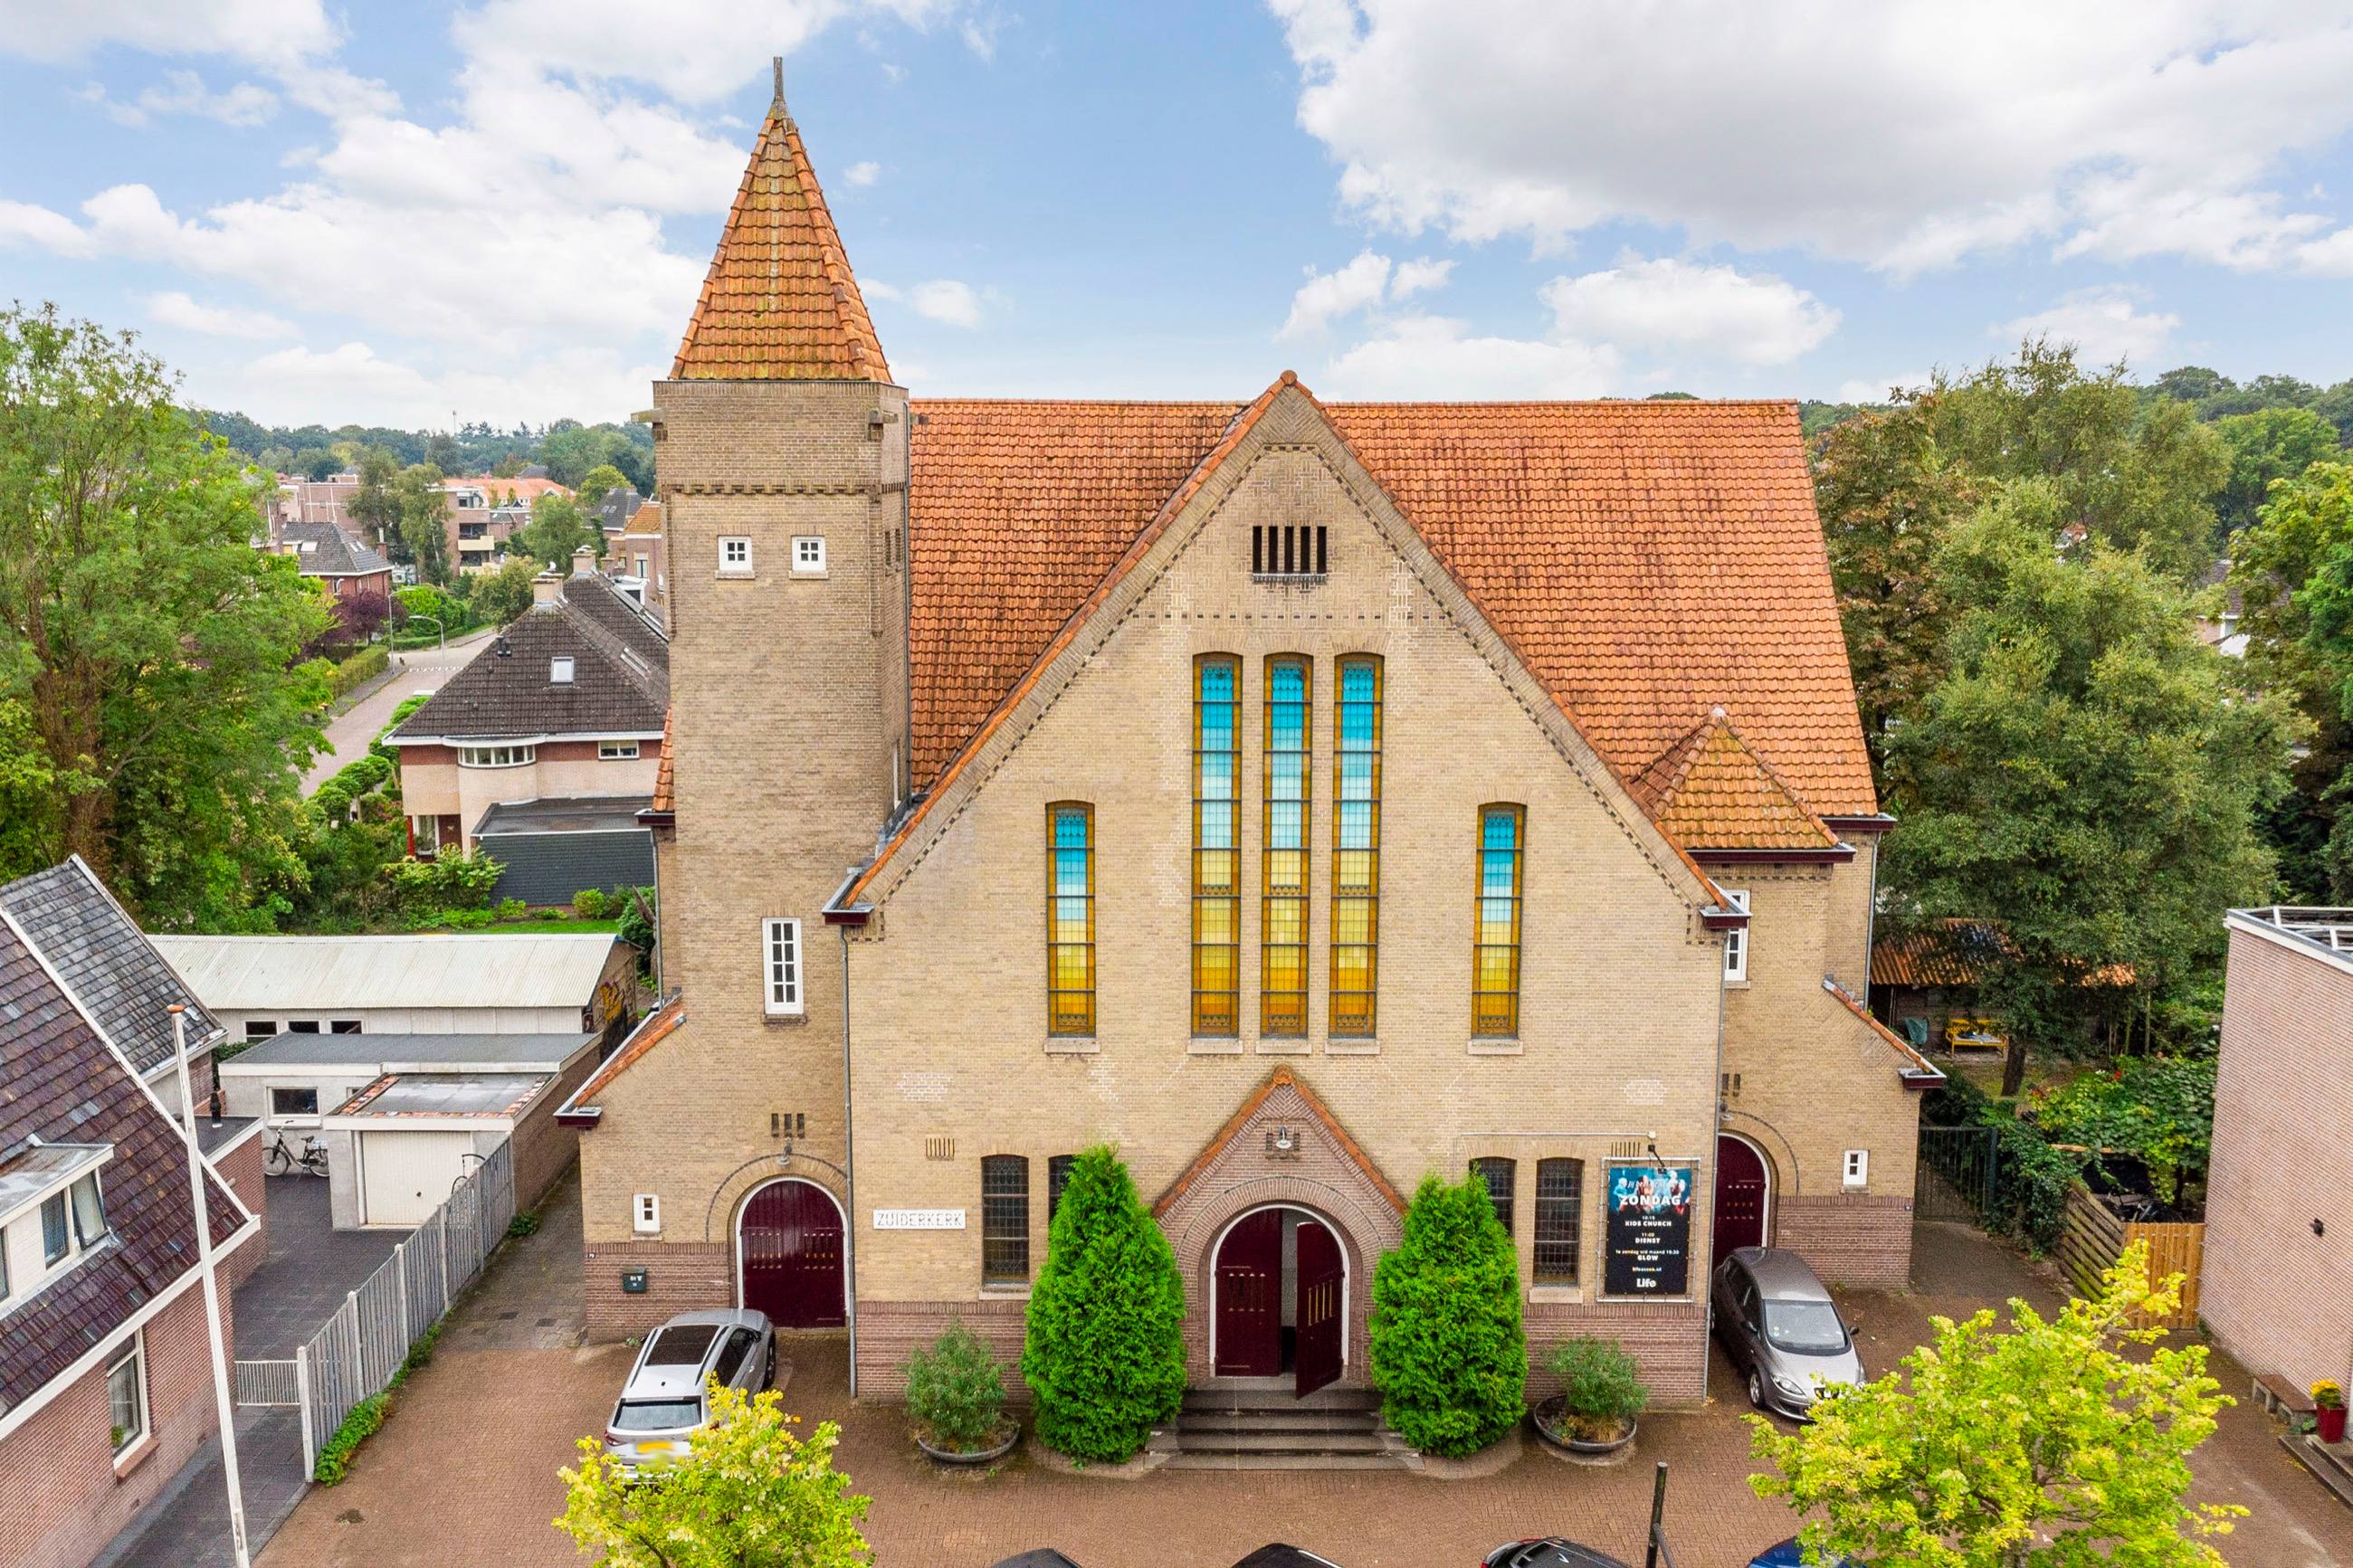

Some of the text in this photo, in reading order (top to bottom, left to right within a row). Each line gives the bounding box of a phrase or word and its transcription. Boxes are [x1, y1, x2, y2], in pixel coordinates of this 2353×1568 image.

[1620, 1195, 1681, 1206] ZONDAG
[877, 1212, 962, 1227] ZUIDERKERK
[1636, 1278, 1656, 1288] Life
